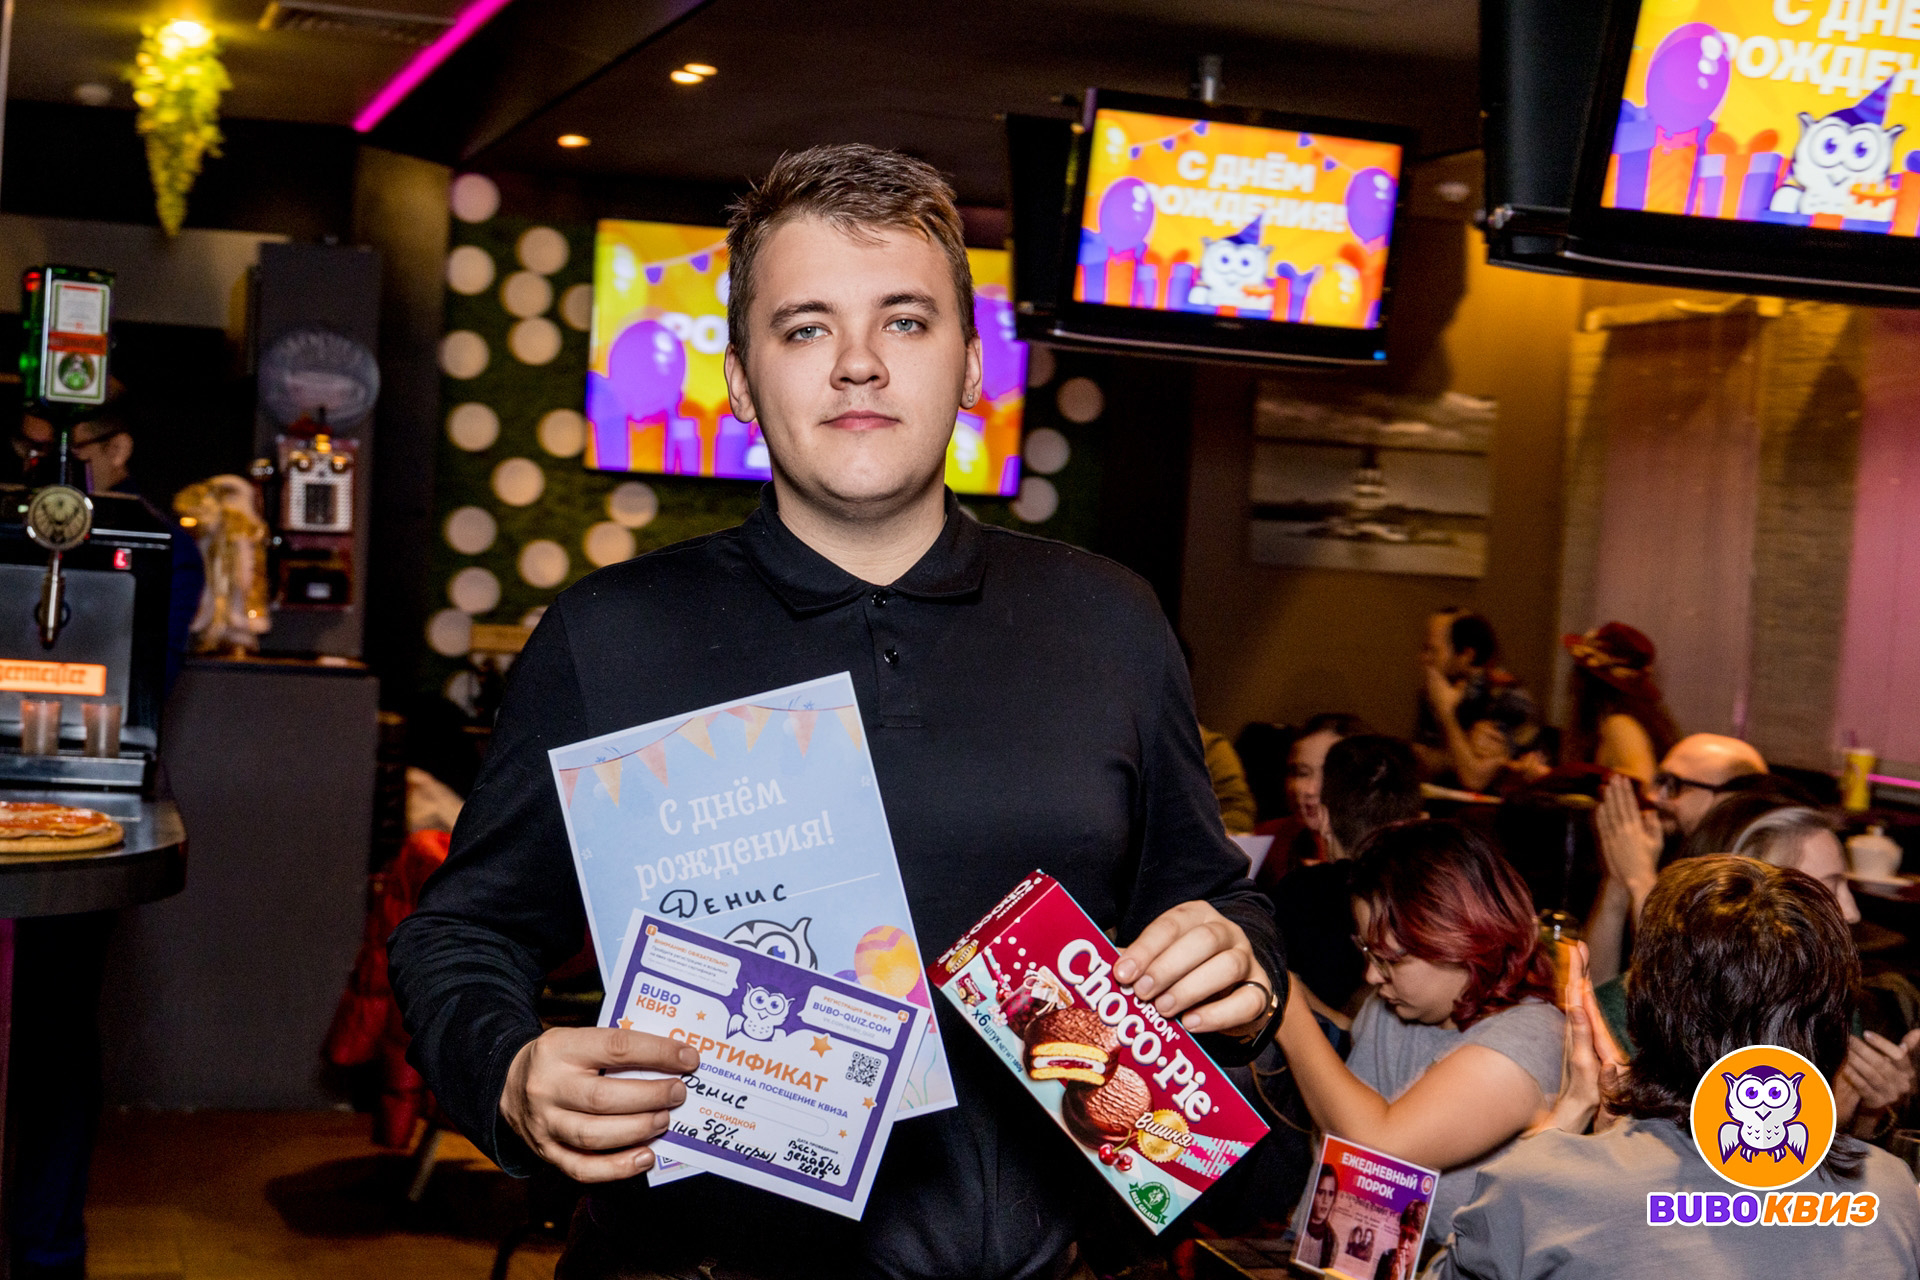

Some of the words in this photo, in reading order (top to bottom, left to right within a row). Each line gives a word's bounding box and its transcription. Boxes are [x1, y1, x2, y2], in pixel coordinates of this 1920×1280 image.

[1772, 0, 1812, 26] С
[1177, 150, 1208, 181] С
[1209, 152, 1317, 194] ДНЁМ
[658, 798, 682, 836] С
[688, 776, 787, 835] днём
[634, 809, 835, 902] рождения!
[658, 883, 787, 918] Денис
[636, 995, 677, 1018] КВИЗ
[640, 983, 681, 1005] BUBO
[812, 1001, 892, 1035] BUBO-QUIZ.COM
[699, 1062, 741, 1083] ЕЛОВЕКА
[743, 1076, 757, 1088] НА
[758, 1081, 816, 1108] ПОСЕЩЕНИЕ
[817, 1101, 849, 1119] КВИЗА
[699, 1106, 712, 1117] СО
[713, 1111, 757, 1131] СКИДКОЙ
[703, 1118, 740, 1140] 50%
[1135, 1111, 1192, 1147] Вишня
[1341, 1151, 1418, 1191] ЕЖЕДНЕВНЫЙ
[1356, 1175, 1395, 1200] ПОРОК
